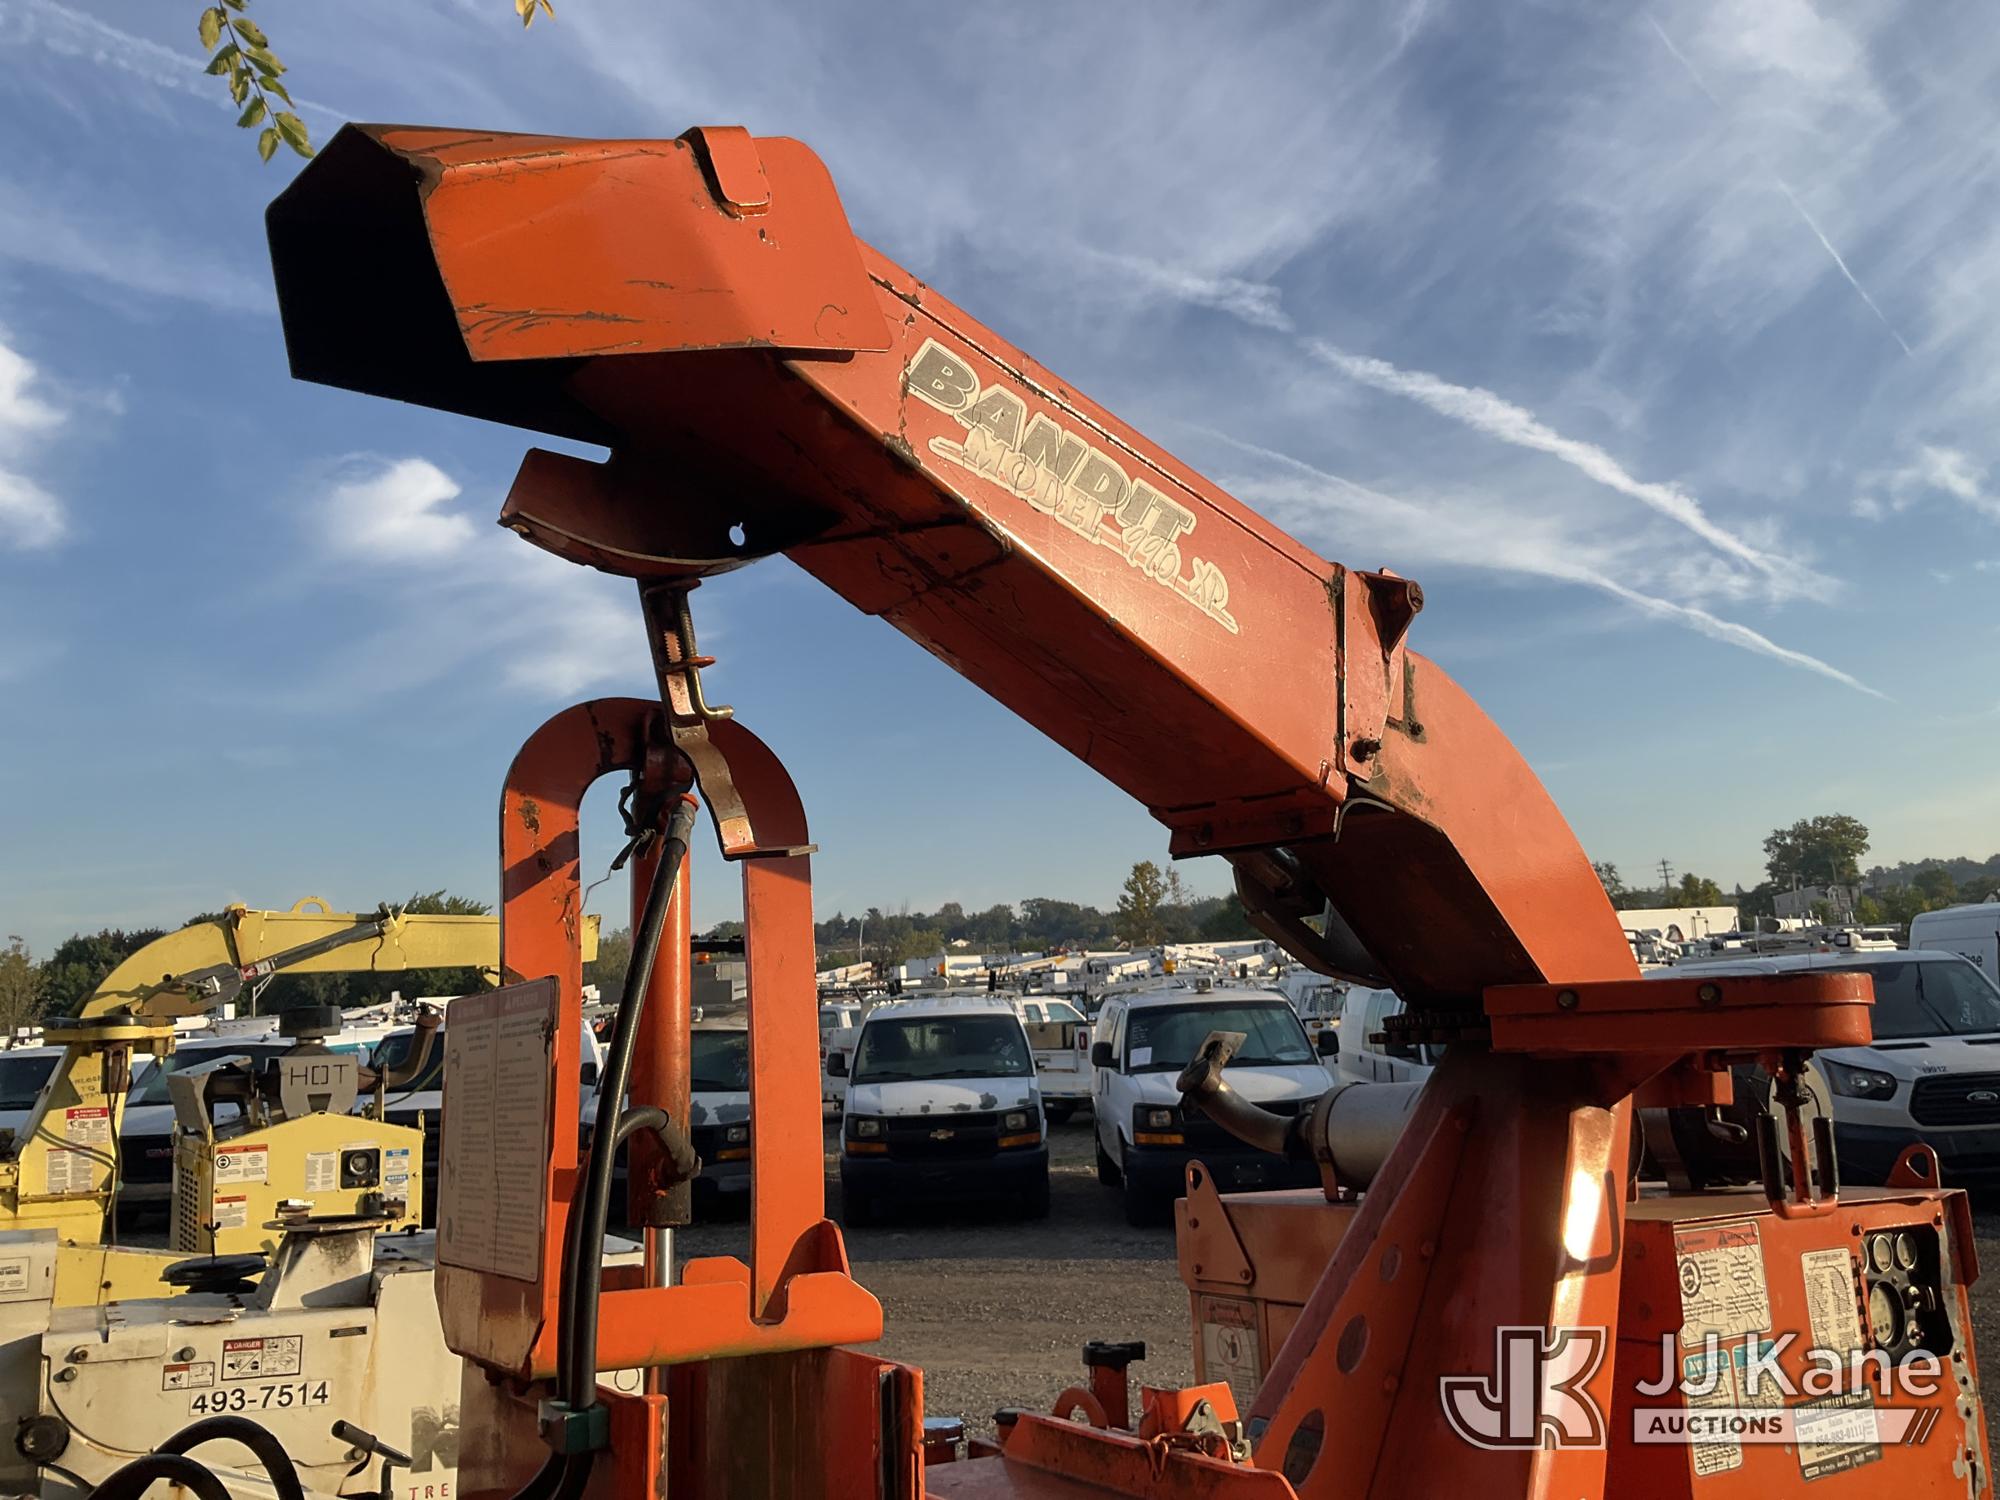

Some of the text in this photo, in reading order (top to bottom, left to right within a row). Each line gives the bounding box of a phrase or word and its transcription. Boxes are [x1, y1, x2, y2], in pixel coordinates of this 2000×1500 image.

[901, 338, 1197, 546] BANDIT
[963, 424, 1104, 542] MODEL
[1958, 951, 1983, 968] ee
[290, 1064, 348, 1087] HOT
[233, 1340, 261, 1350] DANGER
[191, 1380, 329, 1414] 493-7514
